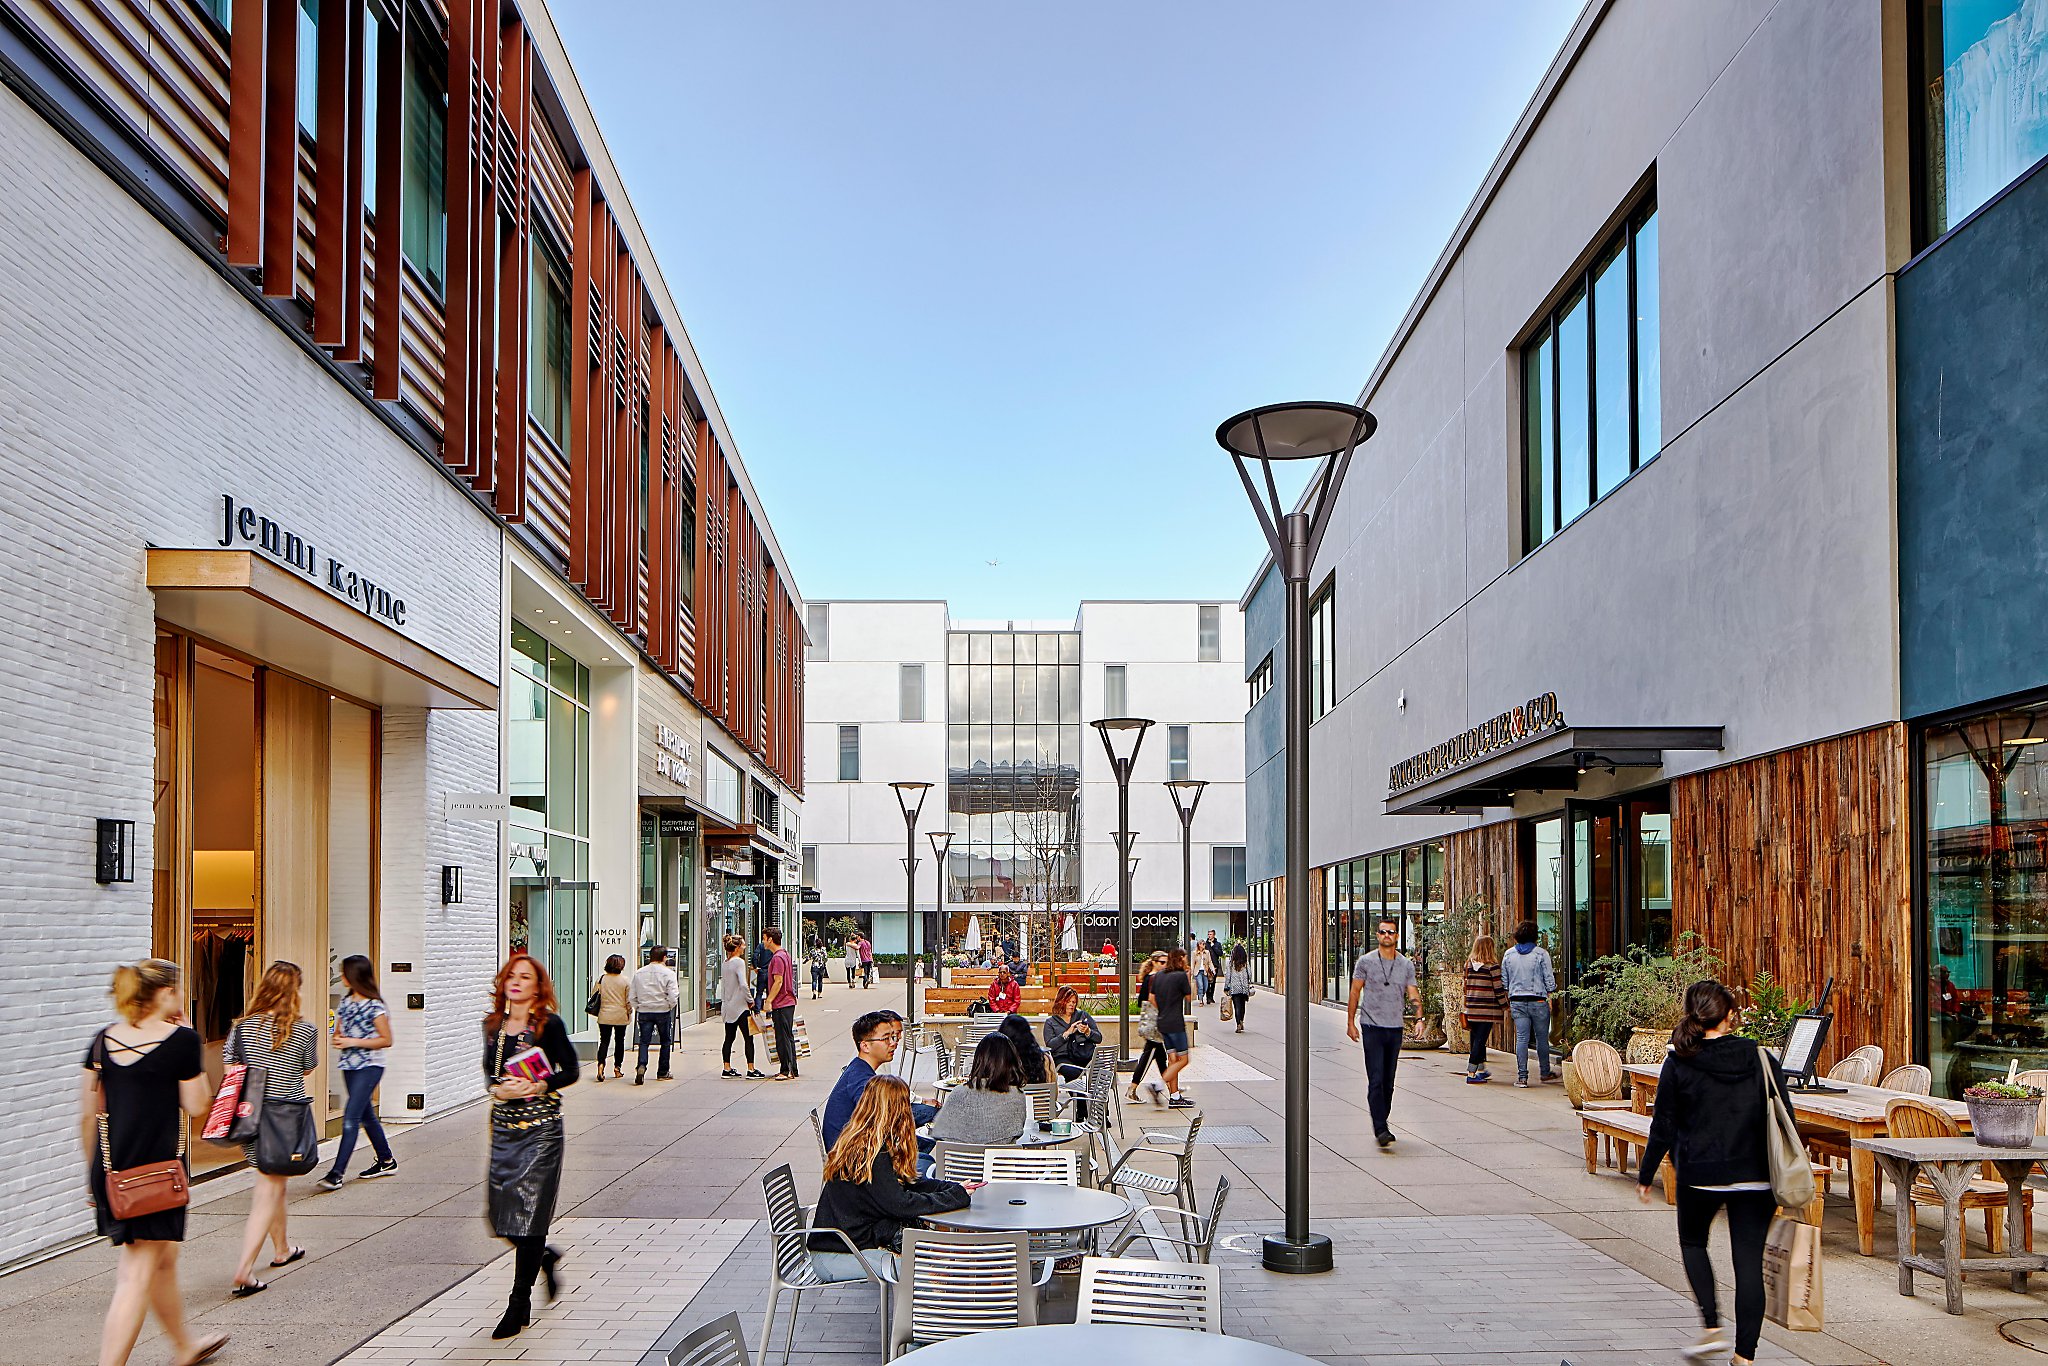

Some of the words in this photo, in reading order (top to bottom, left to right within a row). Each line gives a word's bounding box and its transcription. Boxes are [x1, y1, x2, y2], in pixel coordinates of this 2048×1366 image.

[1084, 913, 1178, 929] bloomgdale's
[594, 928, 627, 936] AMOUR
[600, 937, 621, 945] VERT
